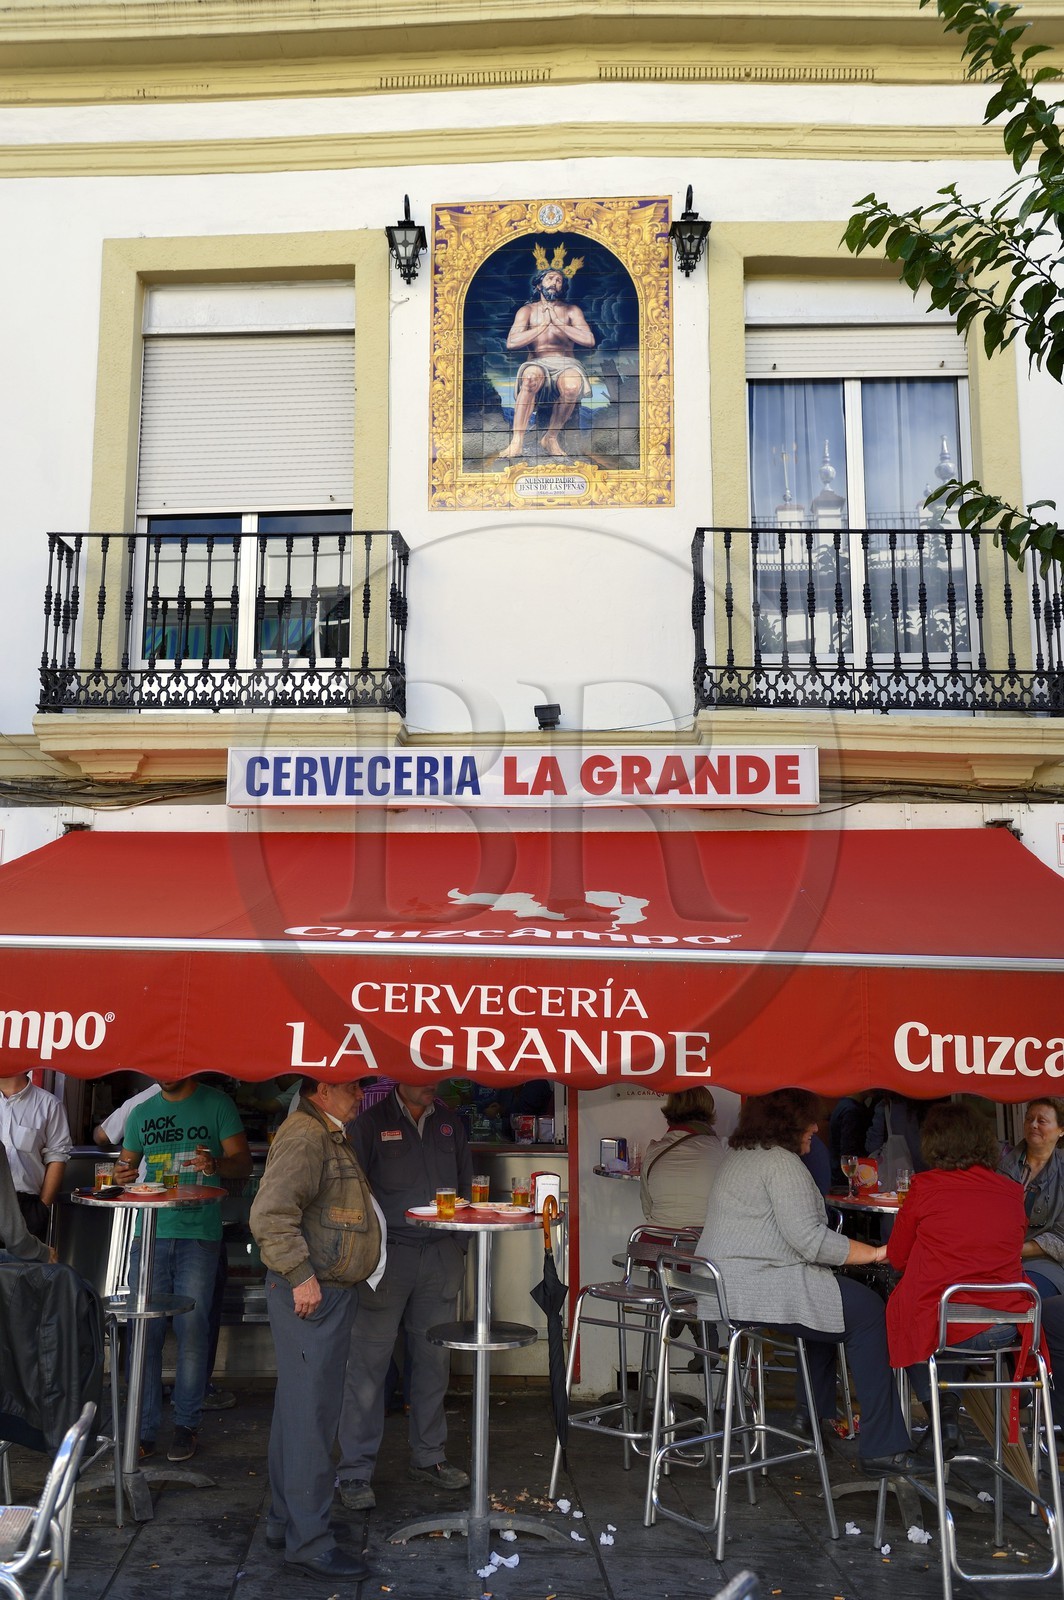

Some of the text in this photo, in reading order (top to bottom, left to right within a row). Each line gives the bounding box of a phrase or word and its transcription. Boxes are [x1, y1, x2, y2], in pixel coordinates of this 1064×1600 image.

[245, 754, 801, 797] CERVECERIA LA GRANDE
[351, 977, 649, 1019] CERVECERÍA
[286, 1021, 712, 1077] LA GRANDE
[141, 1115, 176, 1132] JACK
[143, 1126, 211, 1145] JONES CO.
